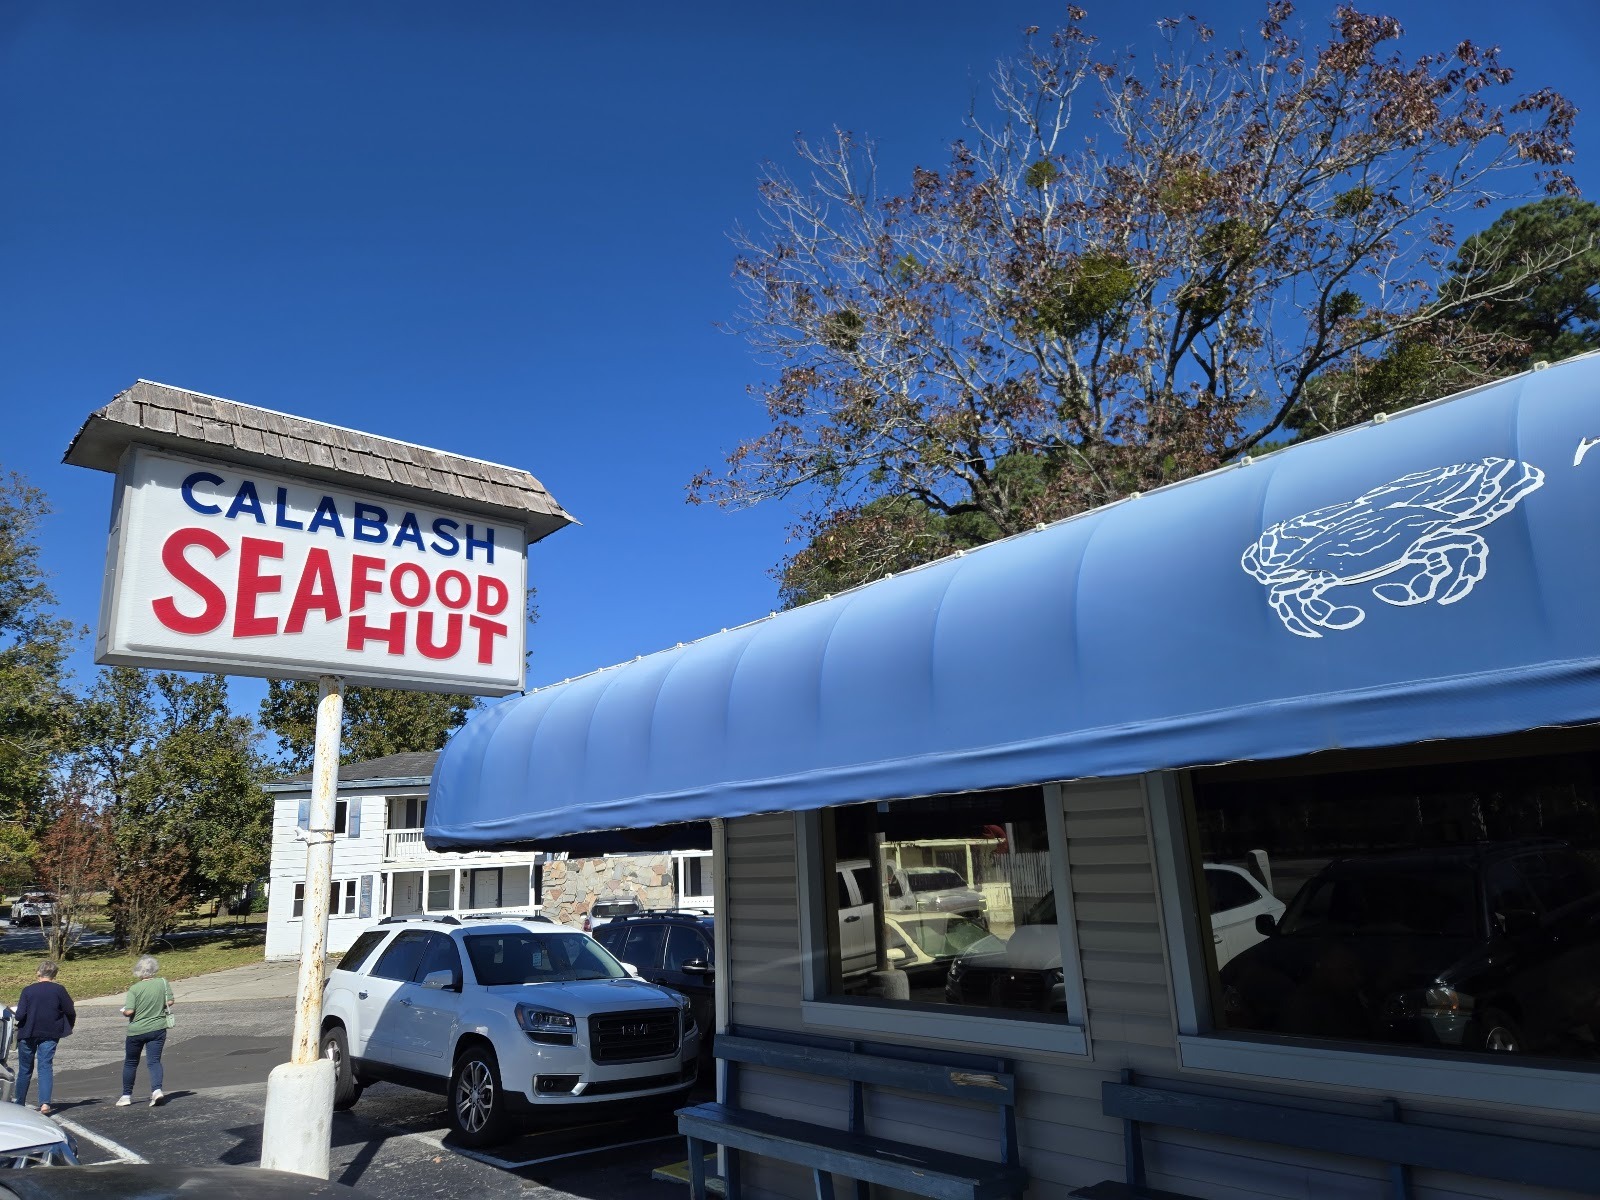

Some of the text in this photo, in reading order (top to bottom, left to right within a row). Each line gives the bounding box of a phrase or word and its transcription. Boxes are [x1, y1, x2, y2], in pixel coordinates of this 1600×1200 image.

[181, 471, 495, 564] CALABASH
[152, 527, 509, 638] SEAFOOD
[346, 611, 508, 664] HUT
